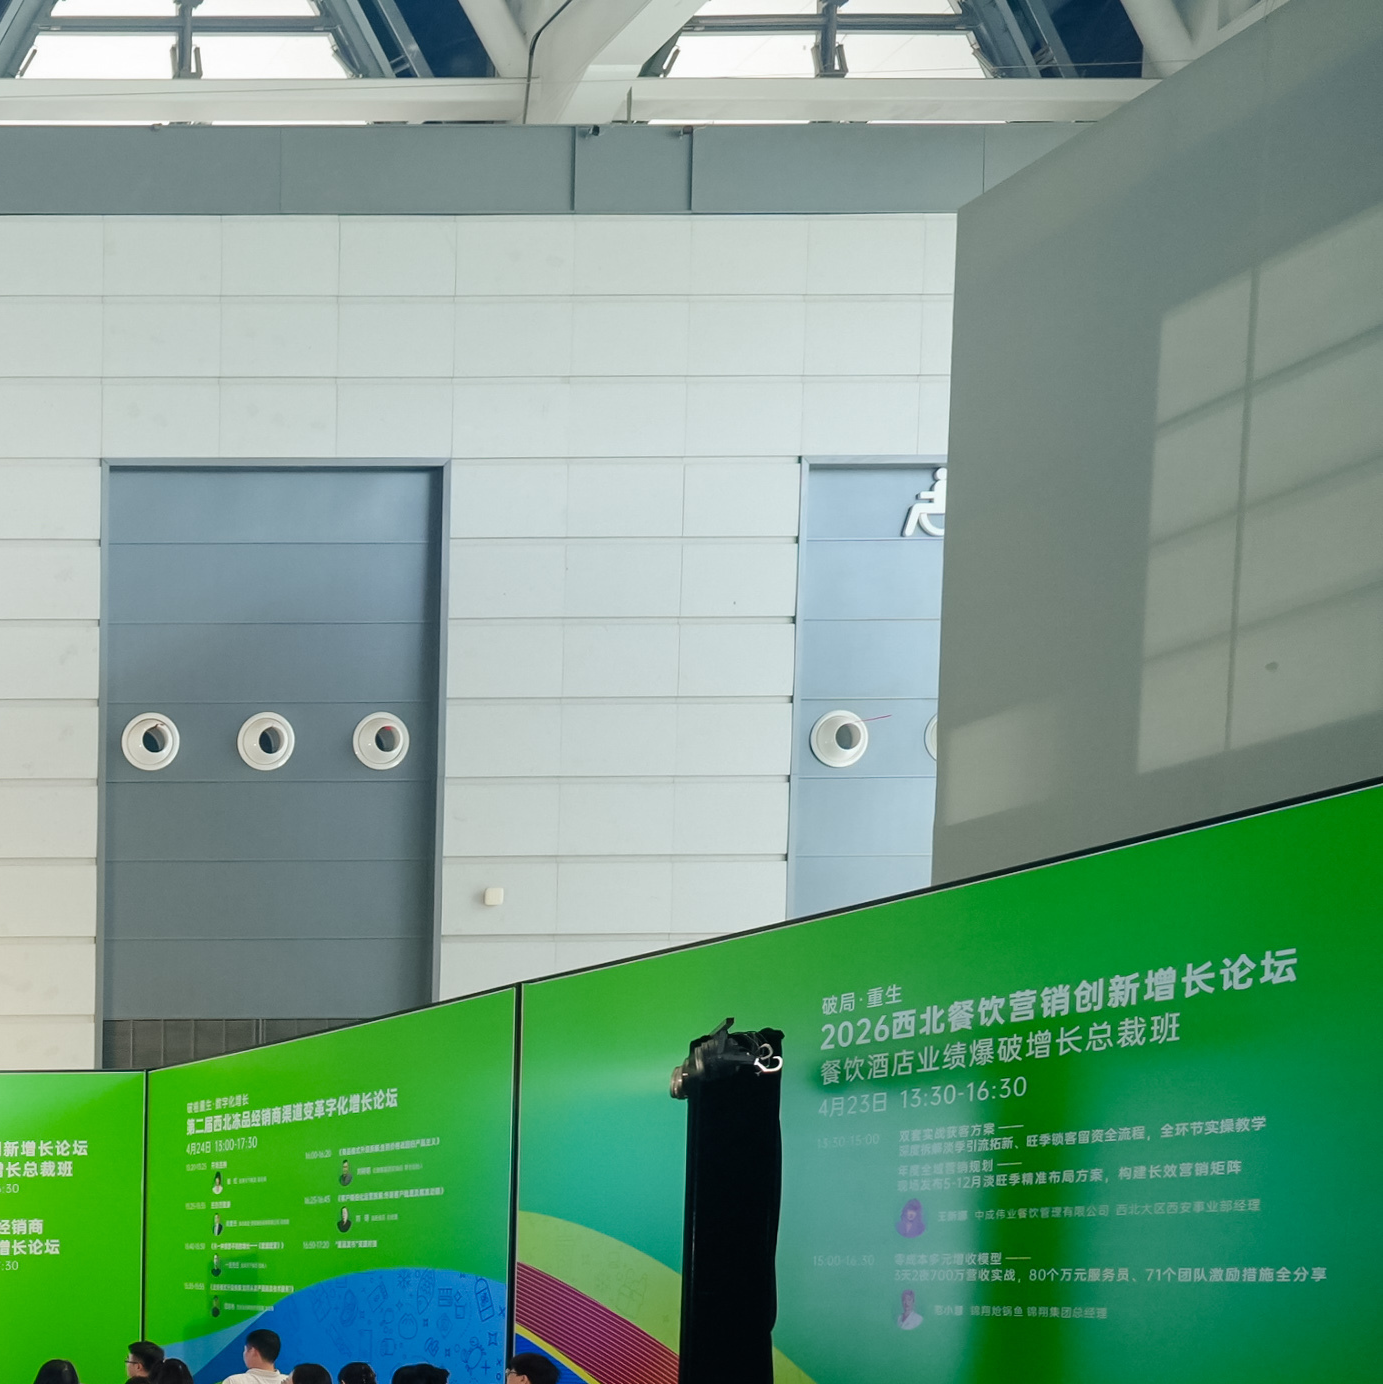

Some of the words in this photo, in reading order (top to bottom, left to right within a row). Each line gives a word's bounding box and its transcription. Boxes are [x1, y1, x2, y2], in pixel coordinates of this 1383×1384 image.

[819, 947, 1298, 1051] 2026西北餐饮营销创新增长论坛
[821, 983, 903, 1016] 破局·重生
[819, 1011, 1181, 1086] 餐饮酒店业绩爆破增长总裁班
[818, 1091, 888, 1118] 4月23日
[900, 1076, 1028, 1109] 13:30-16:30
[186, 1140, 212, 1156] 4月24日
[214, 1136, 258, 1151] 13:00-17:30
